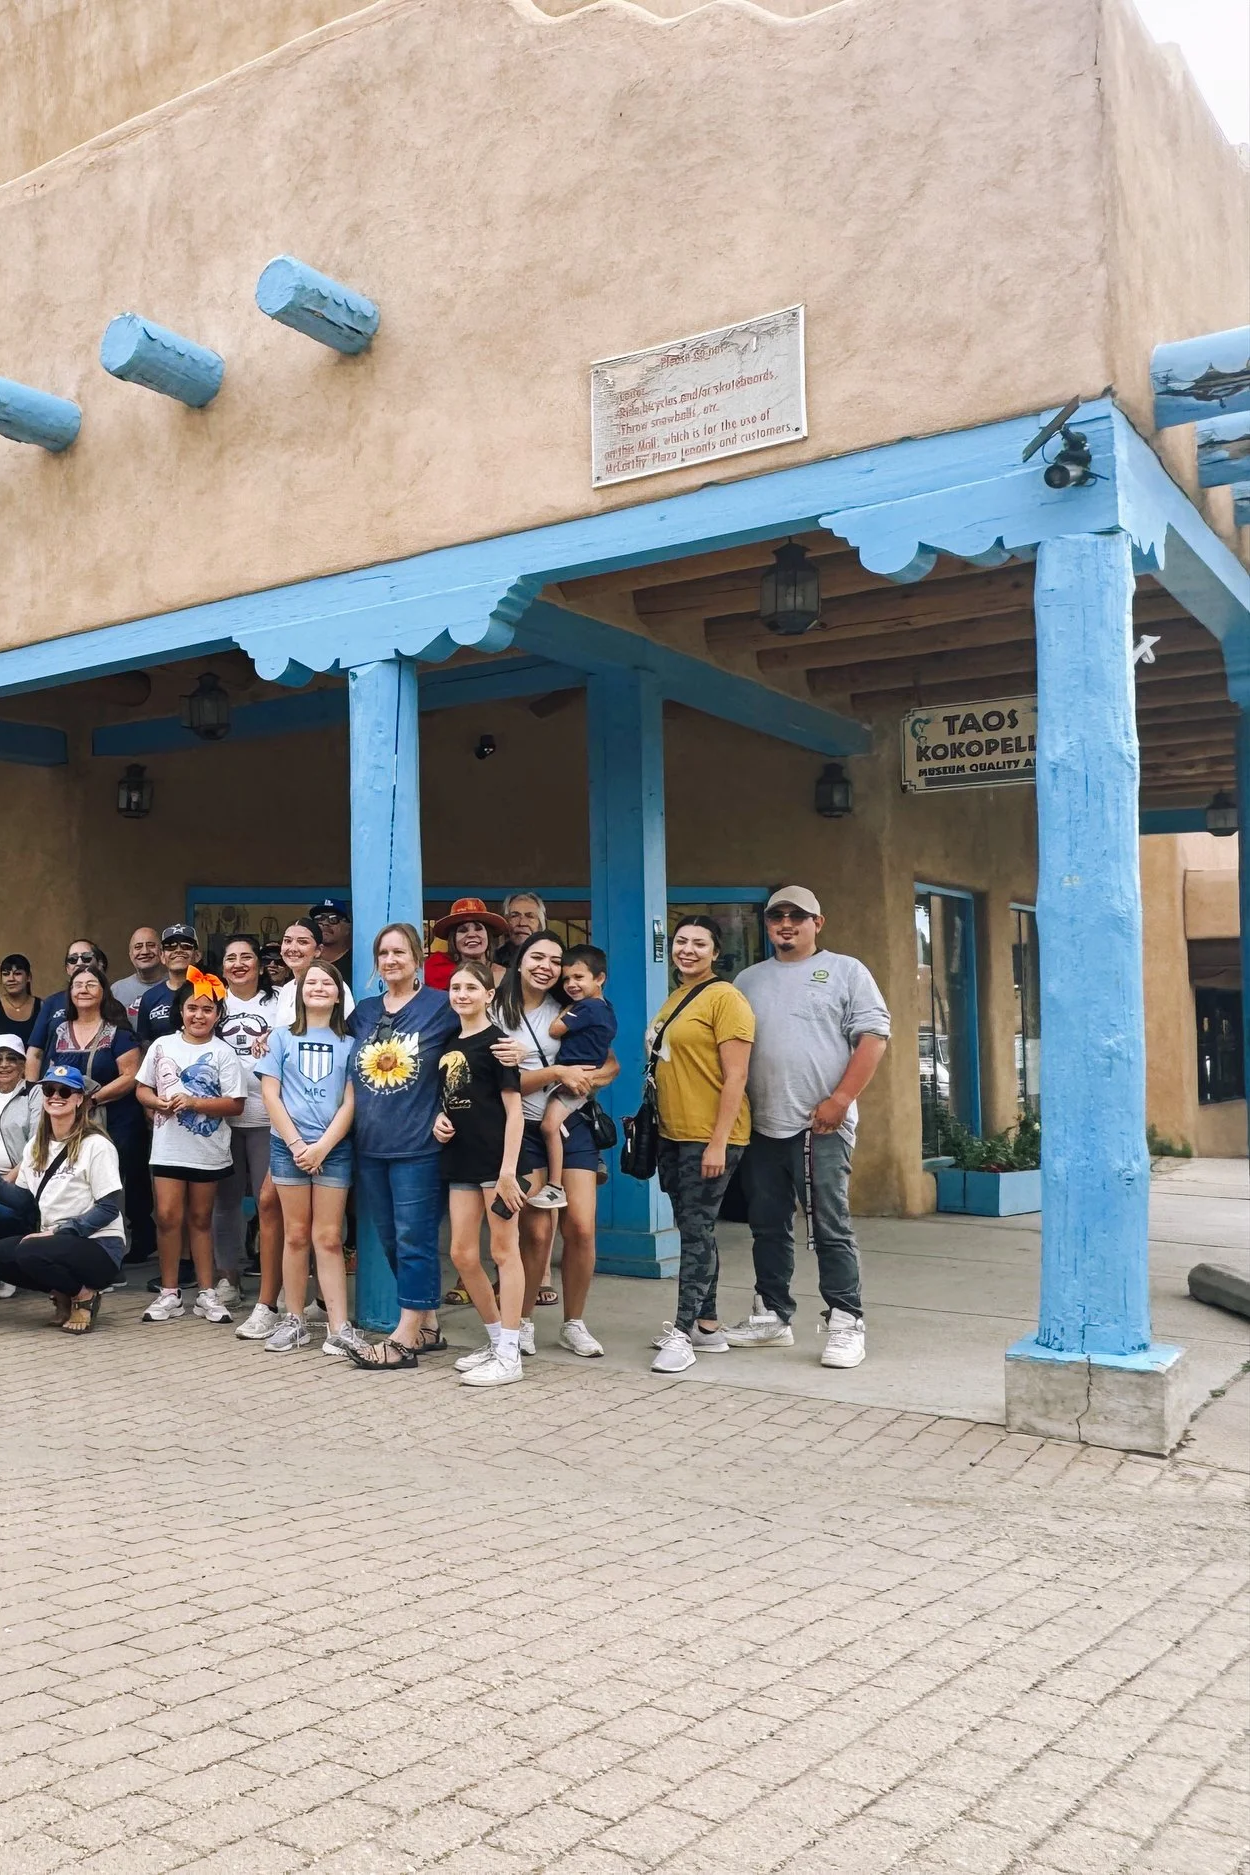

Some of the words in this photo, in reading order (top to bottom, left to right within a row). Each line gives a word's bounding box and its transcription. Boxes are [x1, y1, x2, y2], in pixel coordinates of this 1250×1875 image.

[664, 430, 689, 446] which
[692, 427, 700, 439] is
[703, 422, 717, 436] for
[721, 418, 738, 432] the
[740, 414, 758, 426] use
[760, 407, 771, 421] of
[651, 450, 677, 465] Plaza
[680, 439, 716, 457] tenants
[719, 433, 738, 448] and
[943, 708, 1019, 737] TAOS
[918, 764, 966, 778] MUSEUM
[969, 759, 1020, 773] QUALITY
